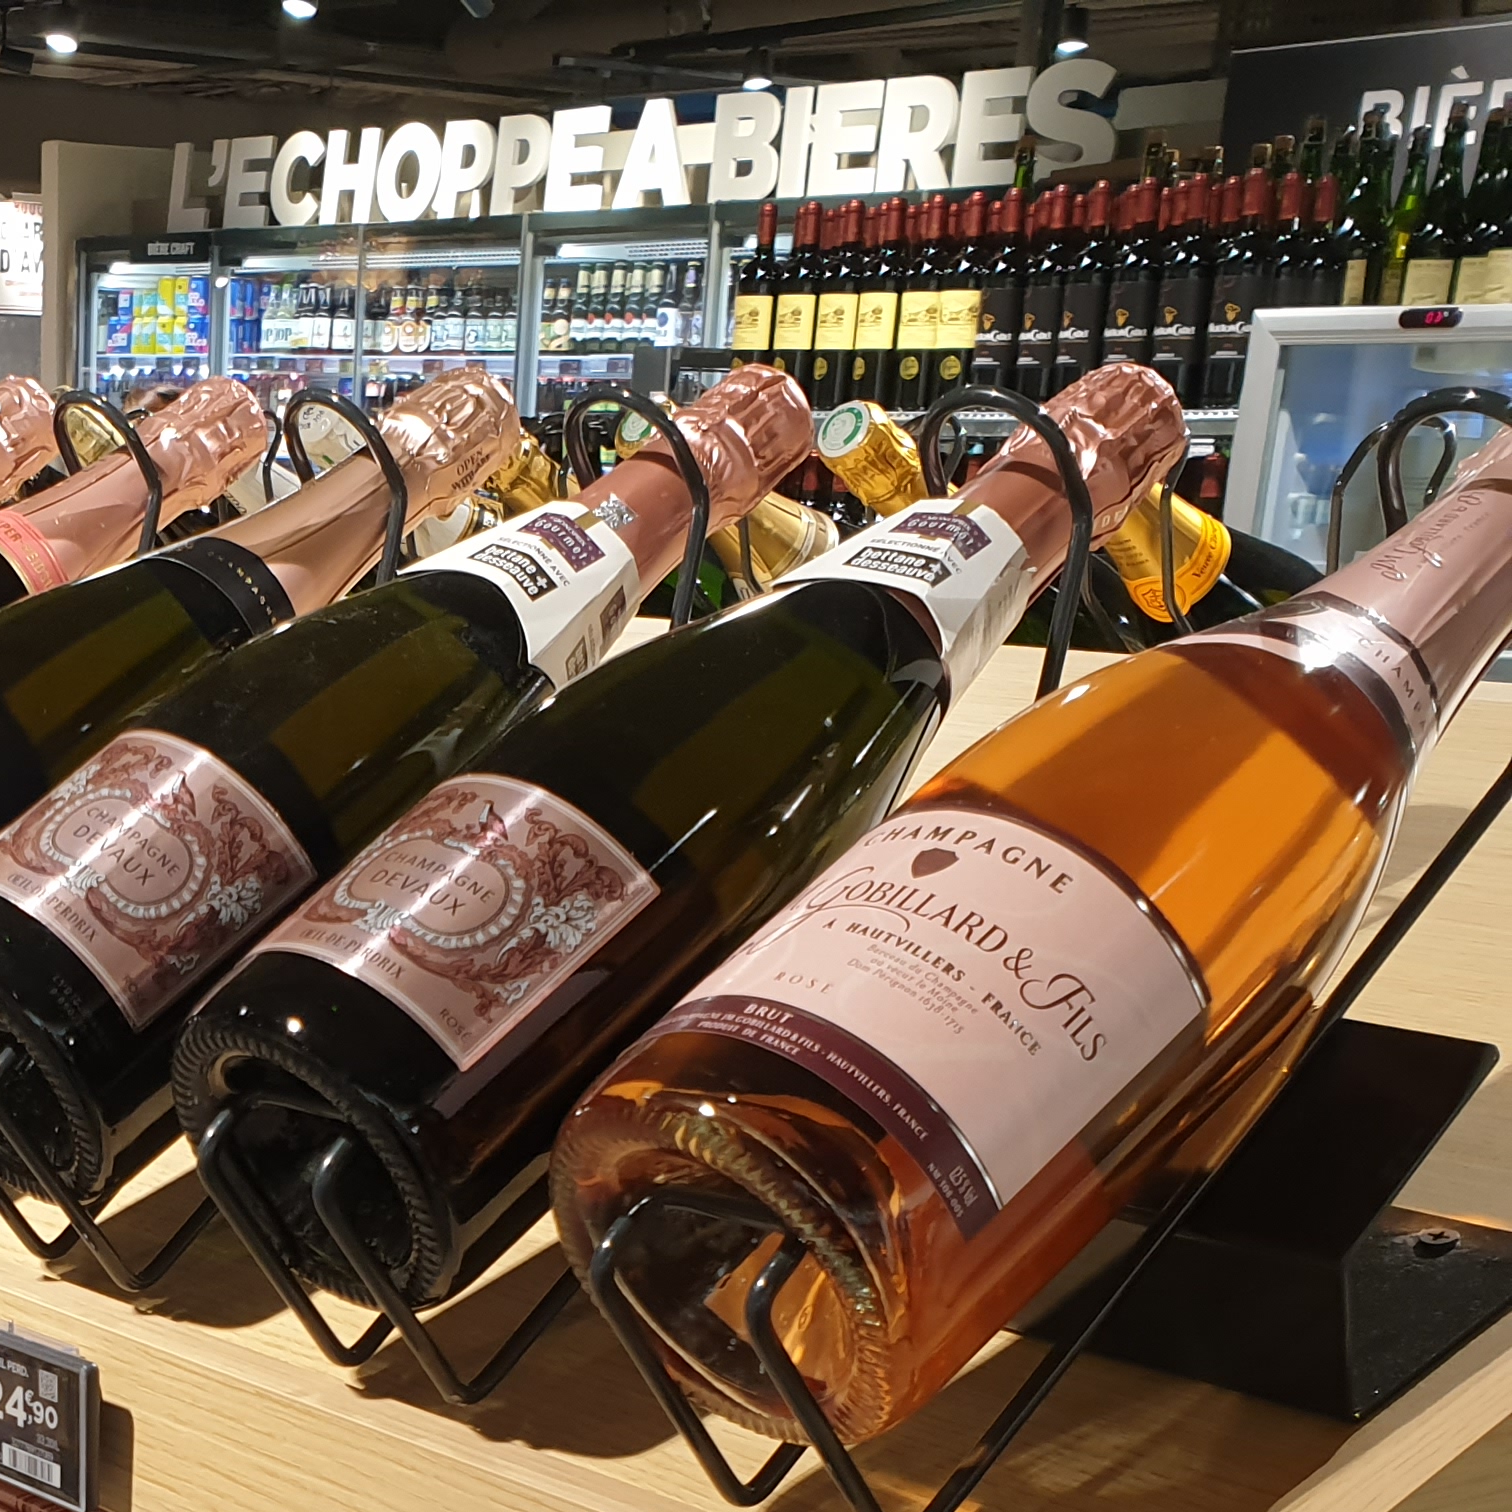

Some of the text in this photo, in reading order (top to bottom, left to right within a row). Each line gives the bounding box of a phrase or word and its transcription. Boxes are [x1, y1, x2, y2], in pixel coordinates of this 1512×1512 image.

[1358, 65, 1512, 151] BIÈ
[611, 97, 691, 208] A
[708, 58, 1118, 202] BIERES
[455, 448, 484, 477] OPEN
[484, 544, 537, 574] bettane
[534, 518, 588, 560] Gourmet
[474, 551, 539, 597] desseauve
[549, 564, 571, 587] AVEC
[850, 556, 936, 582] desseauve
[72, 821, 157, 887] DEVAUX
[84, 803, 183, 879] CHAMPAGNE
[863, 824, 1075, 896] CHAMPAGNE
[367, 868, 467, 919] DEVAUX
[385, 847, 497, 905] CHAMPAGNE
[1002, 947, 1036, 981] &
[845, 921, 1042, 1057] HAUTVILLERS FRANCE
[437, 1006, 473, 1045] ROSÉ
[743, 1002, 795, 1025] BRUT
[697, 1020, 801, 1056] PRODUIT DE FRANCE
[892, 1102, 929, 1142] FRANCE
